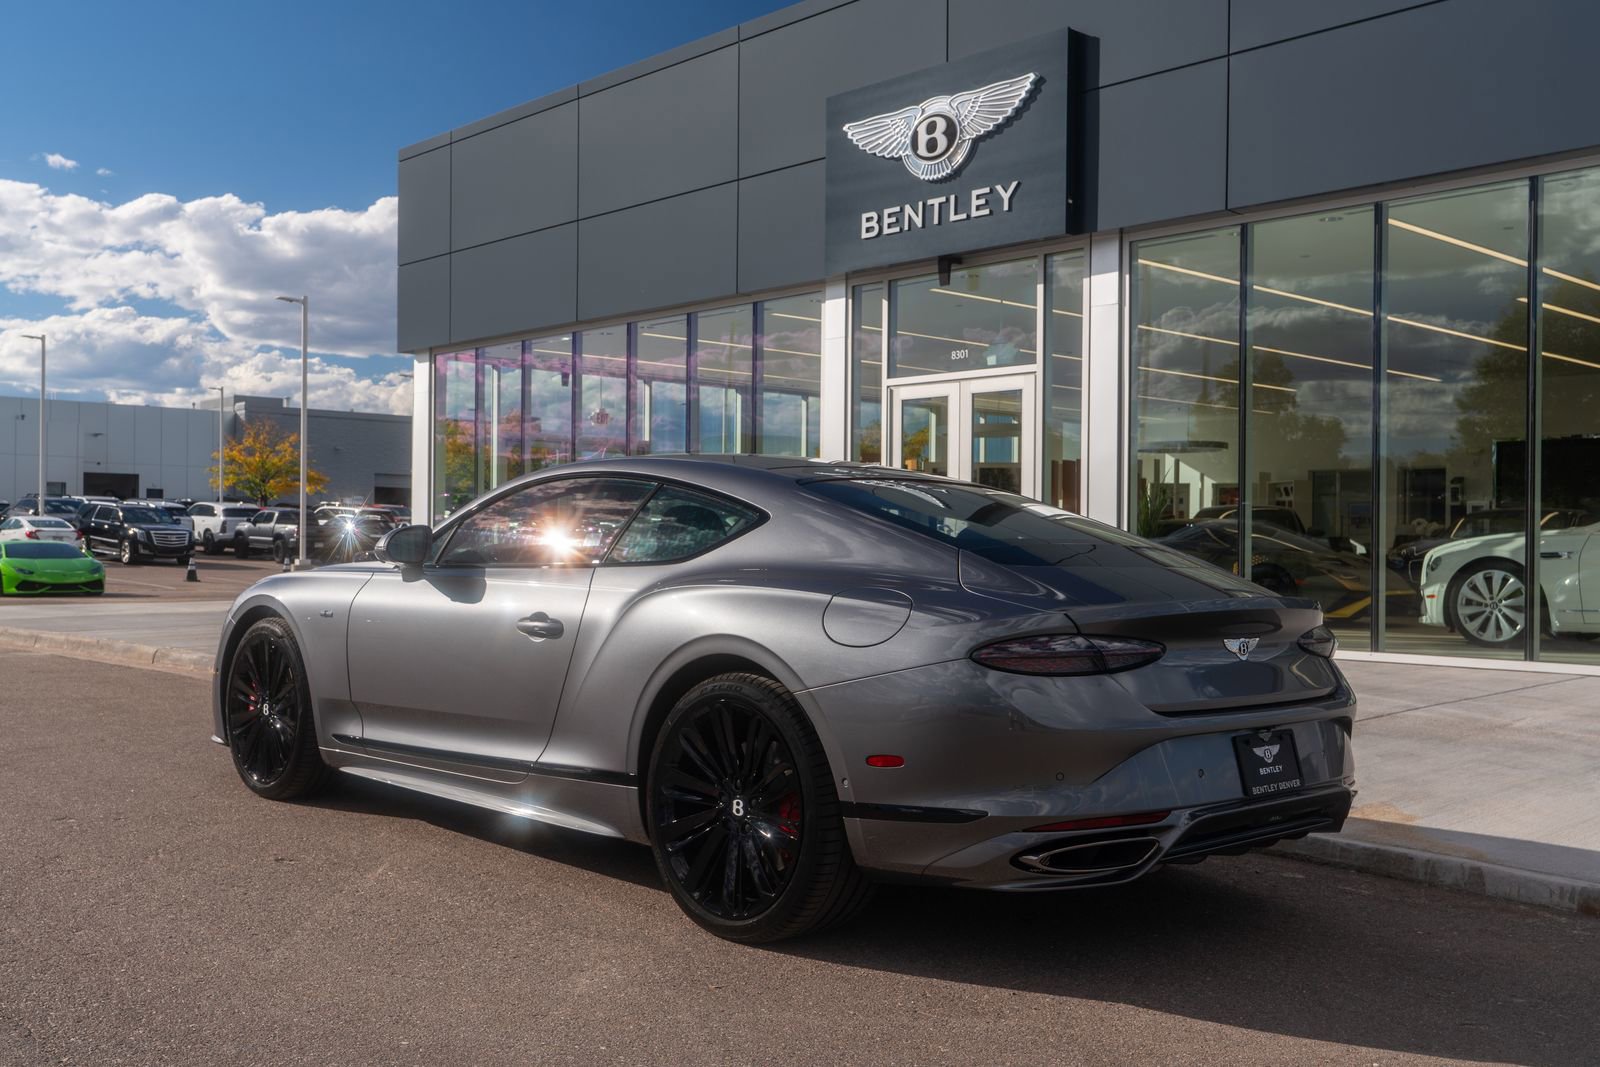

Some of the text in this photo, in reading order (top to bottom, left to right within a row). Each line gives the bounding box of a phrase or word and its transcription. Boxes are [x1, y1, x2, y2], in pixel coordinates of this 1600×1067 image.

[916, 115, 949, 158] B
[860, 180, 1019, 240] BENTLEY
[951, 349, 969, 360] 8301
[1259, 765, 1283, 775] BENTLEY
[1252, 778, 1301, 795] BENTLEY DENVER
[732, 799, 744, 817] B
